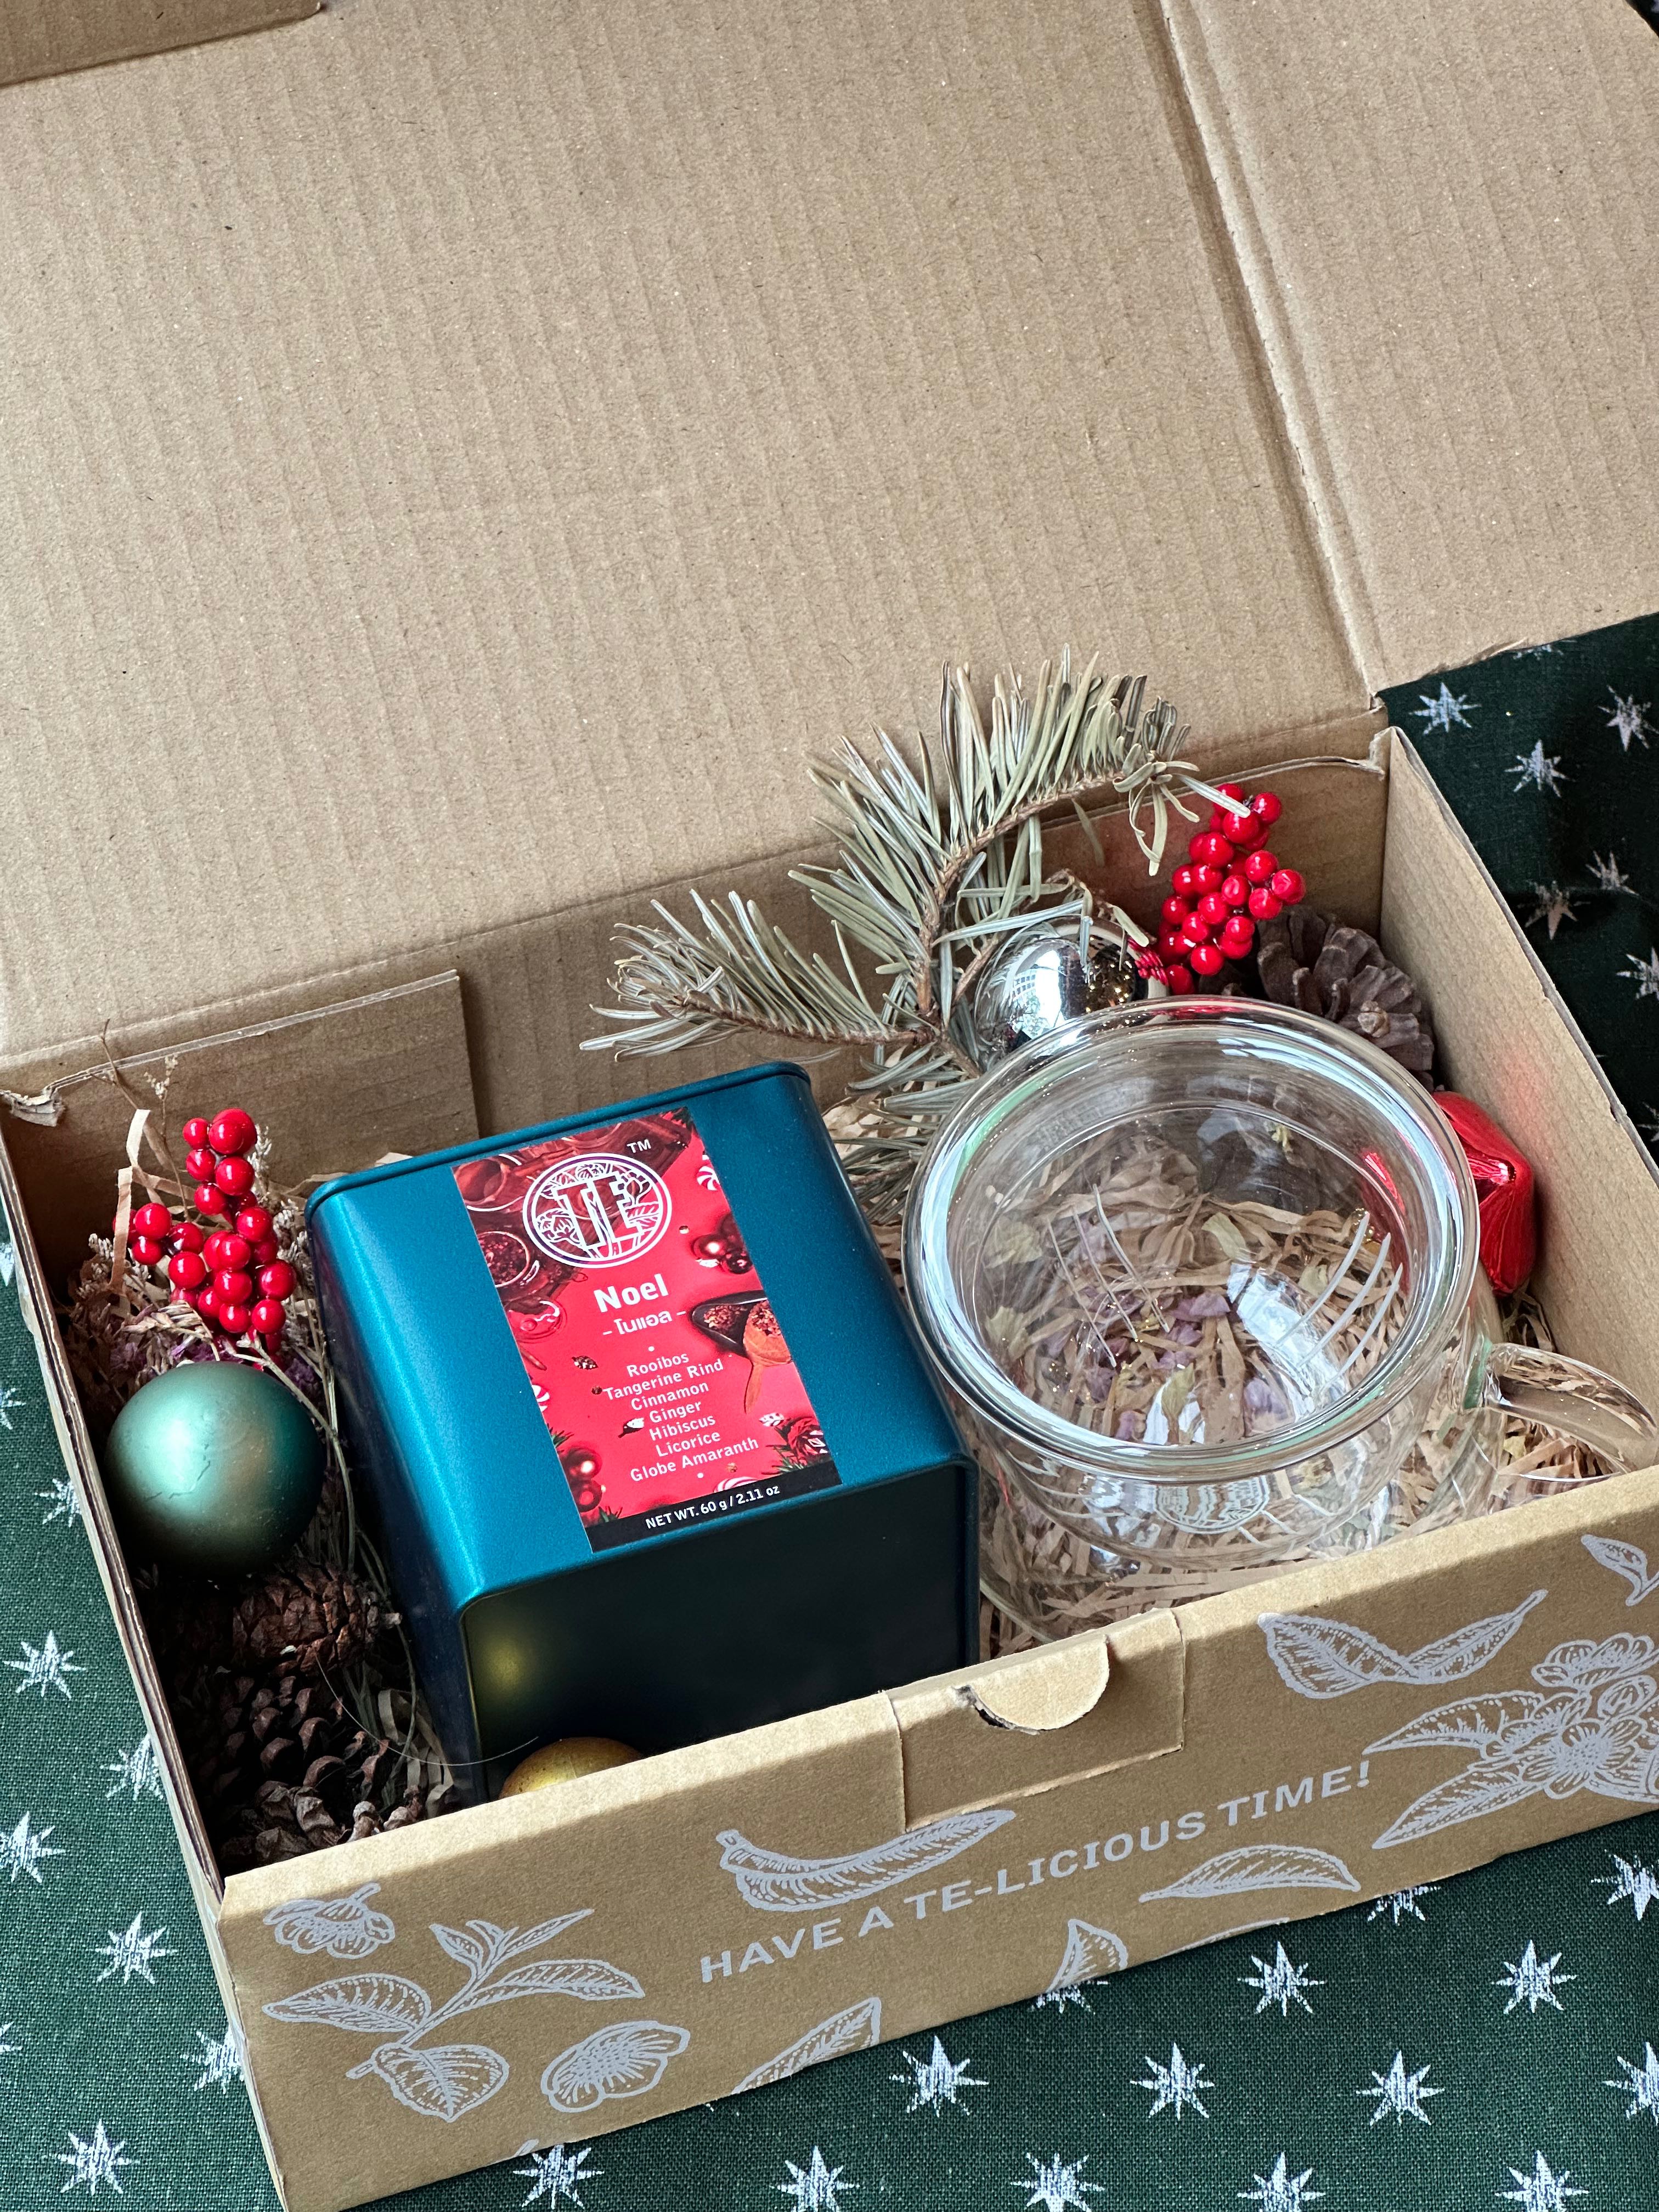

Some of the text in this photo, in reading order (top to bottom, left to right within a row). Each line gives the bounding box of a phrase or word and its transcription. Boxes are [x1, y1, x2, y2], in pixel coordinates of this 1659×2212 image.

[627, 1139, 651, 1153] TM
[593, 1273, 669, 1313] Noel
[602, 1358, 724, 1400] Tangerine Rind
[626, 1353, 689, 1378] Rooibos
[631, 1381, 709, 1410] Cinnamon
[649, 1401, 702, 1423] Ginger
[649, 1415, 716, 1441] Hibiscus
[656, 1431, 721, 1457] Licorice
[630, 1437, 759, 1482] Globe Amaranth
[645, 1513, 672, 1529] NET
[674, 1506, 699, 1521] WT.
[700, 1501, 717, 1514] 60
[736, 1488, 764, 1504] 2.11
[766, 1486, 780, 1496] oz
[700, 1759, 1369, 1983] HAVE A TE-LICIOUS TIME!
